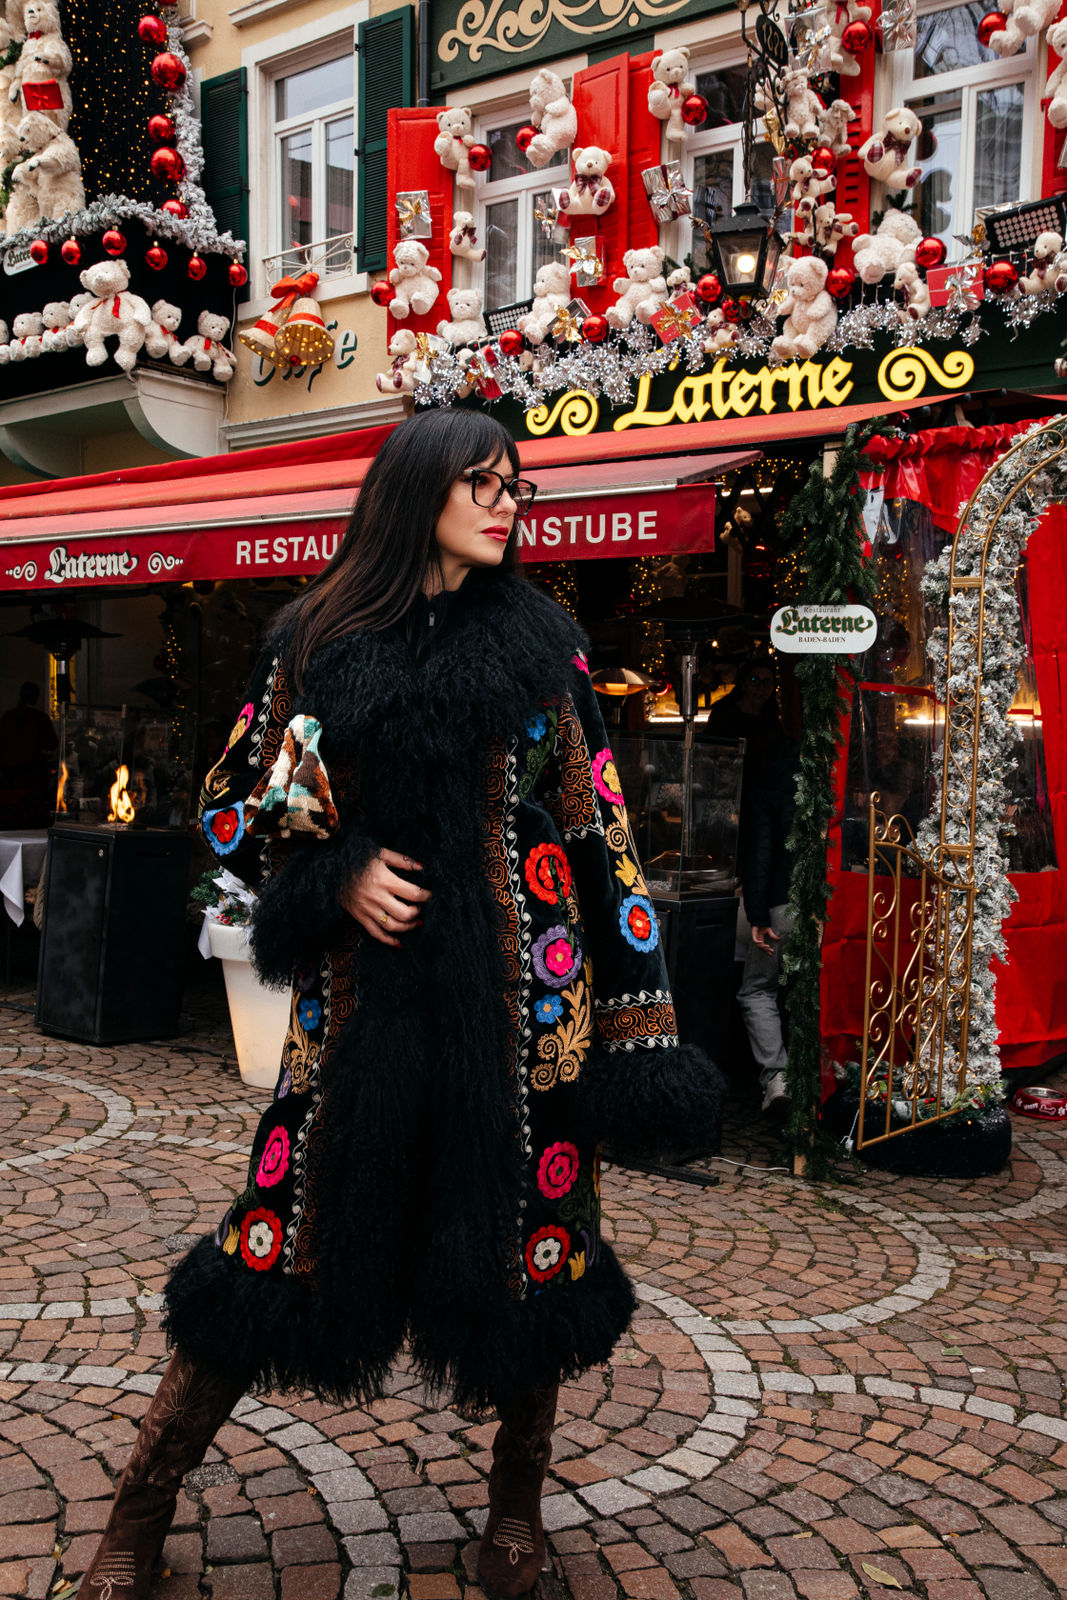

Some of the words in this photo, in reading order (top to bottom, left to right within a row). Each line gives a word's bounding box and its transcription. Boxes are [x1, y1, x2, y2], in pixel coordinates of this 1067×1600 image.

[612, 354, 854, 432] Laterne
[44, 545, 139, 584] Laterne
[235, 533, 346, 565] RESTAU
[775, 608, 874, 636] Laterne
